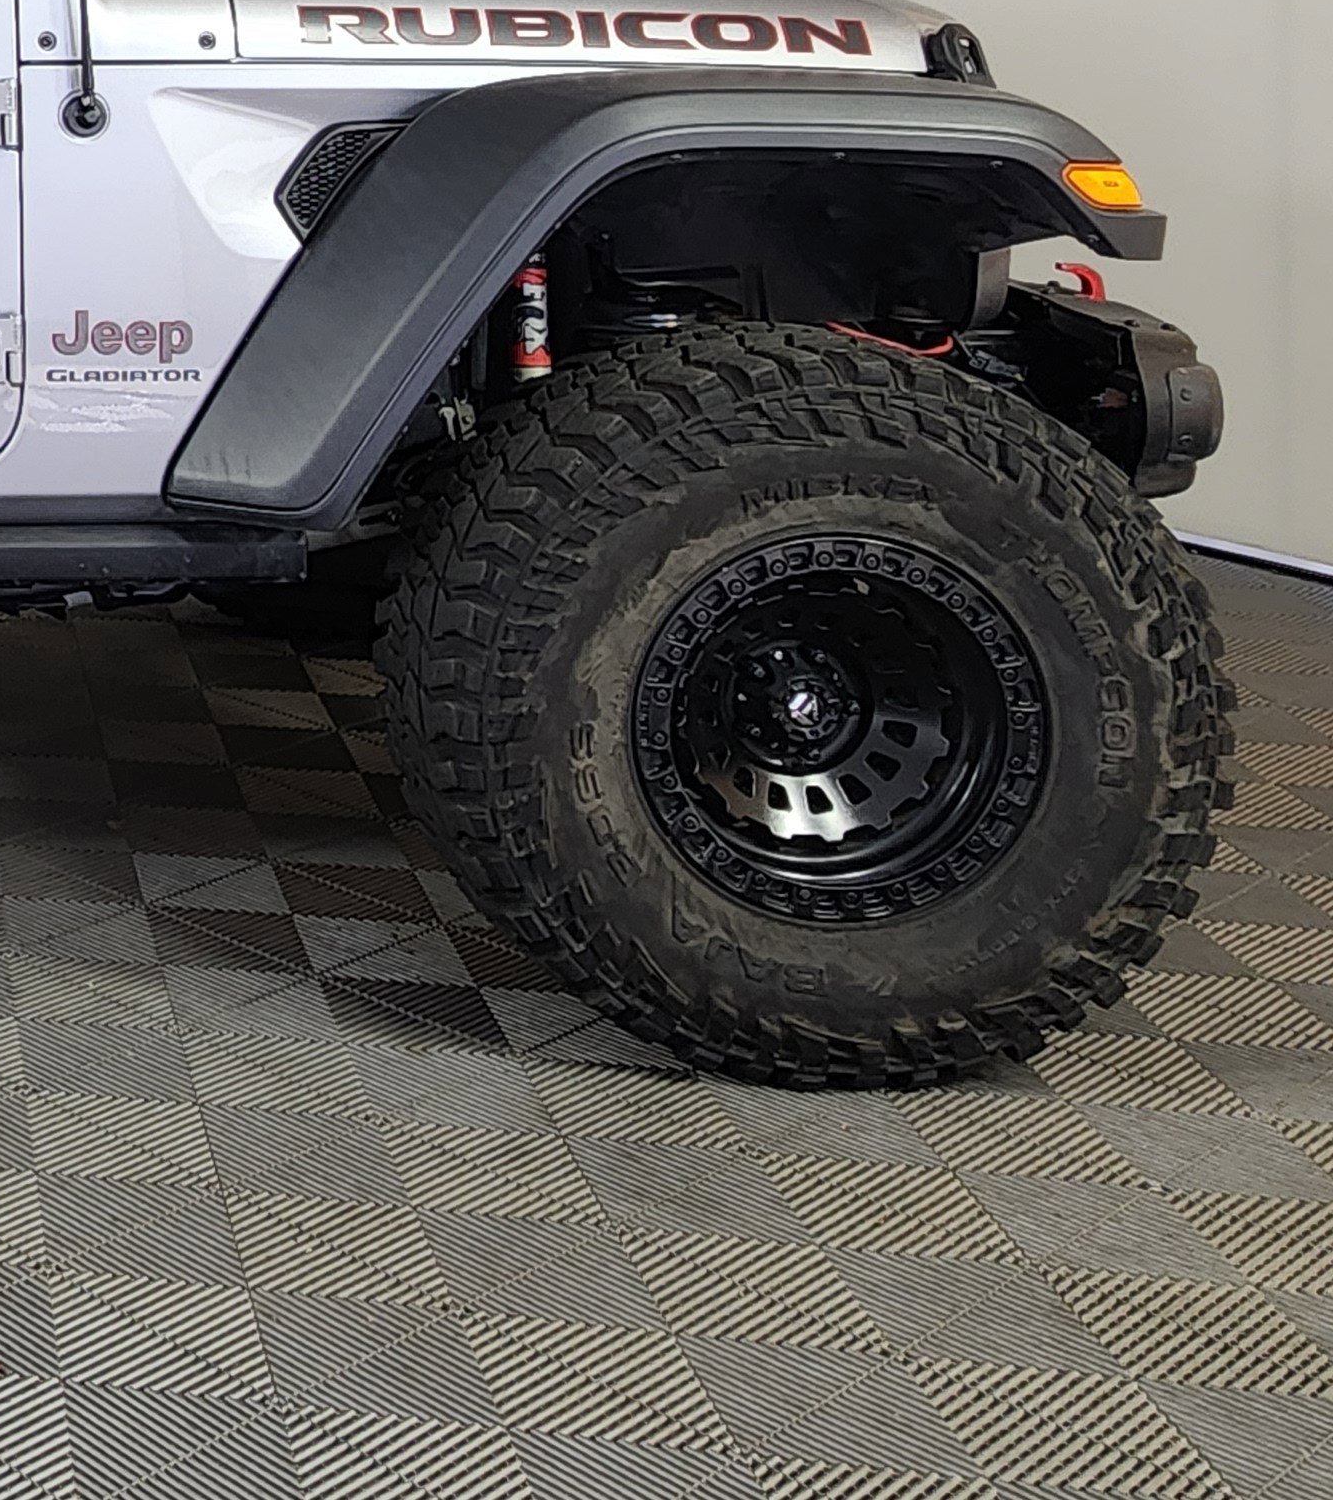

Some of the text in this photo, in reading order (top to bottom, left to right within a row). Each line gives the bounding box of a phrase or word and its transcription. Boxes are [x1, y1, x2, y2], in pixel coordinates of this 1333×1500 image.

[296, 5, 873, 55] RUBICON
[52, 310, 193, 364] Jeep
[46, 369, 201, 382] GLADIATOR
